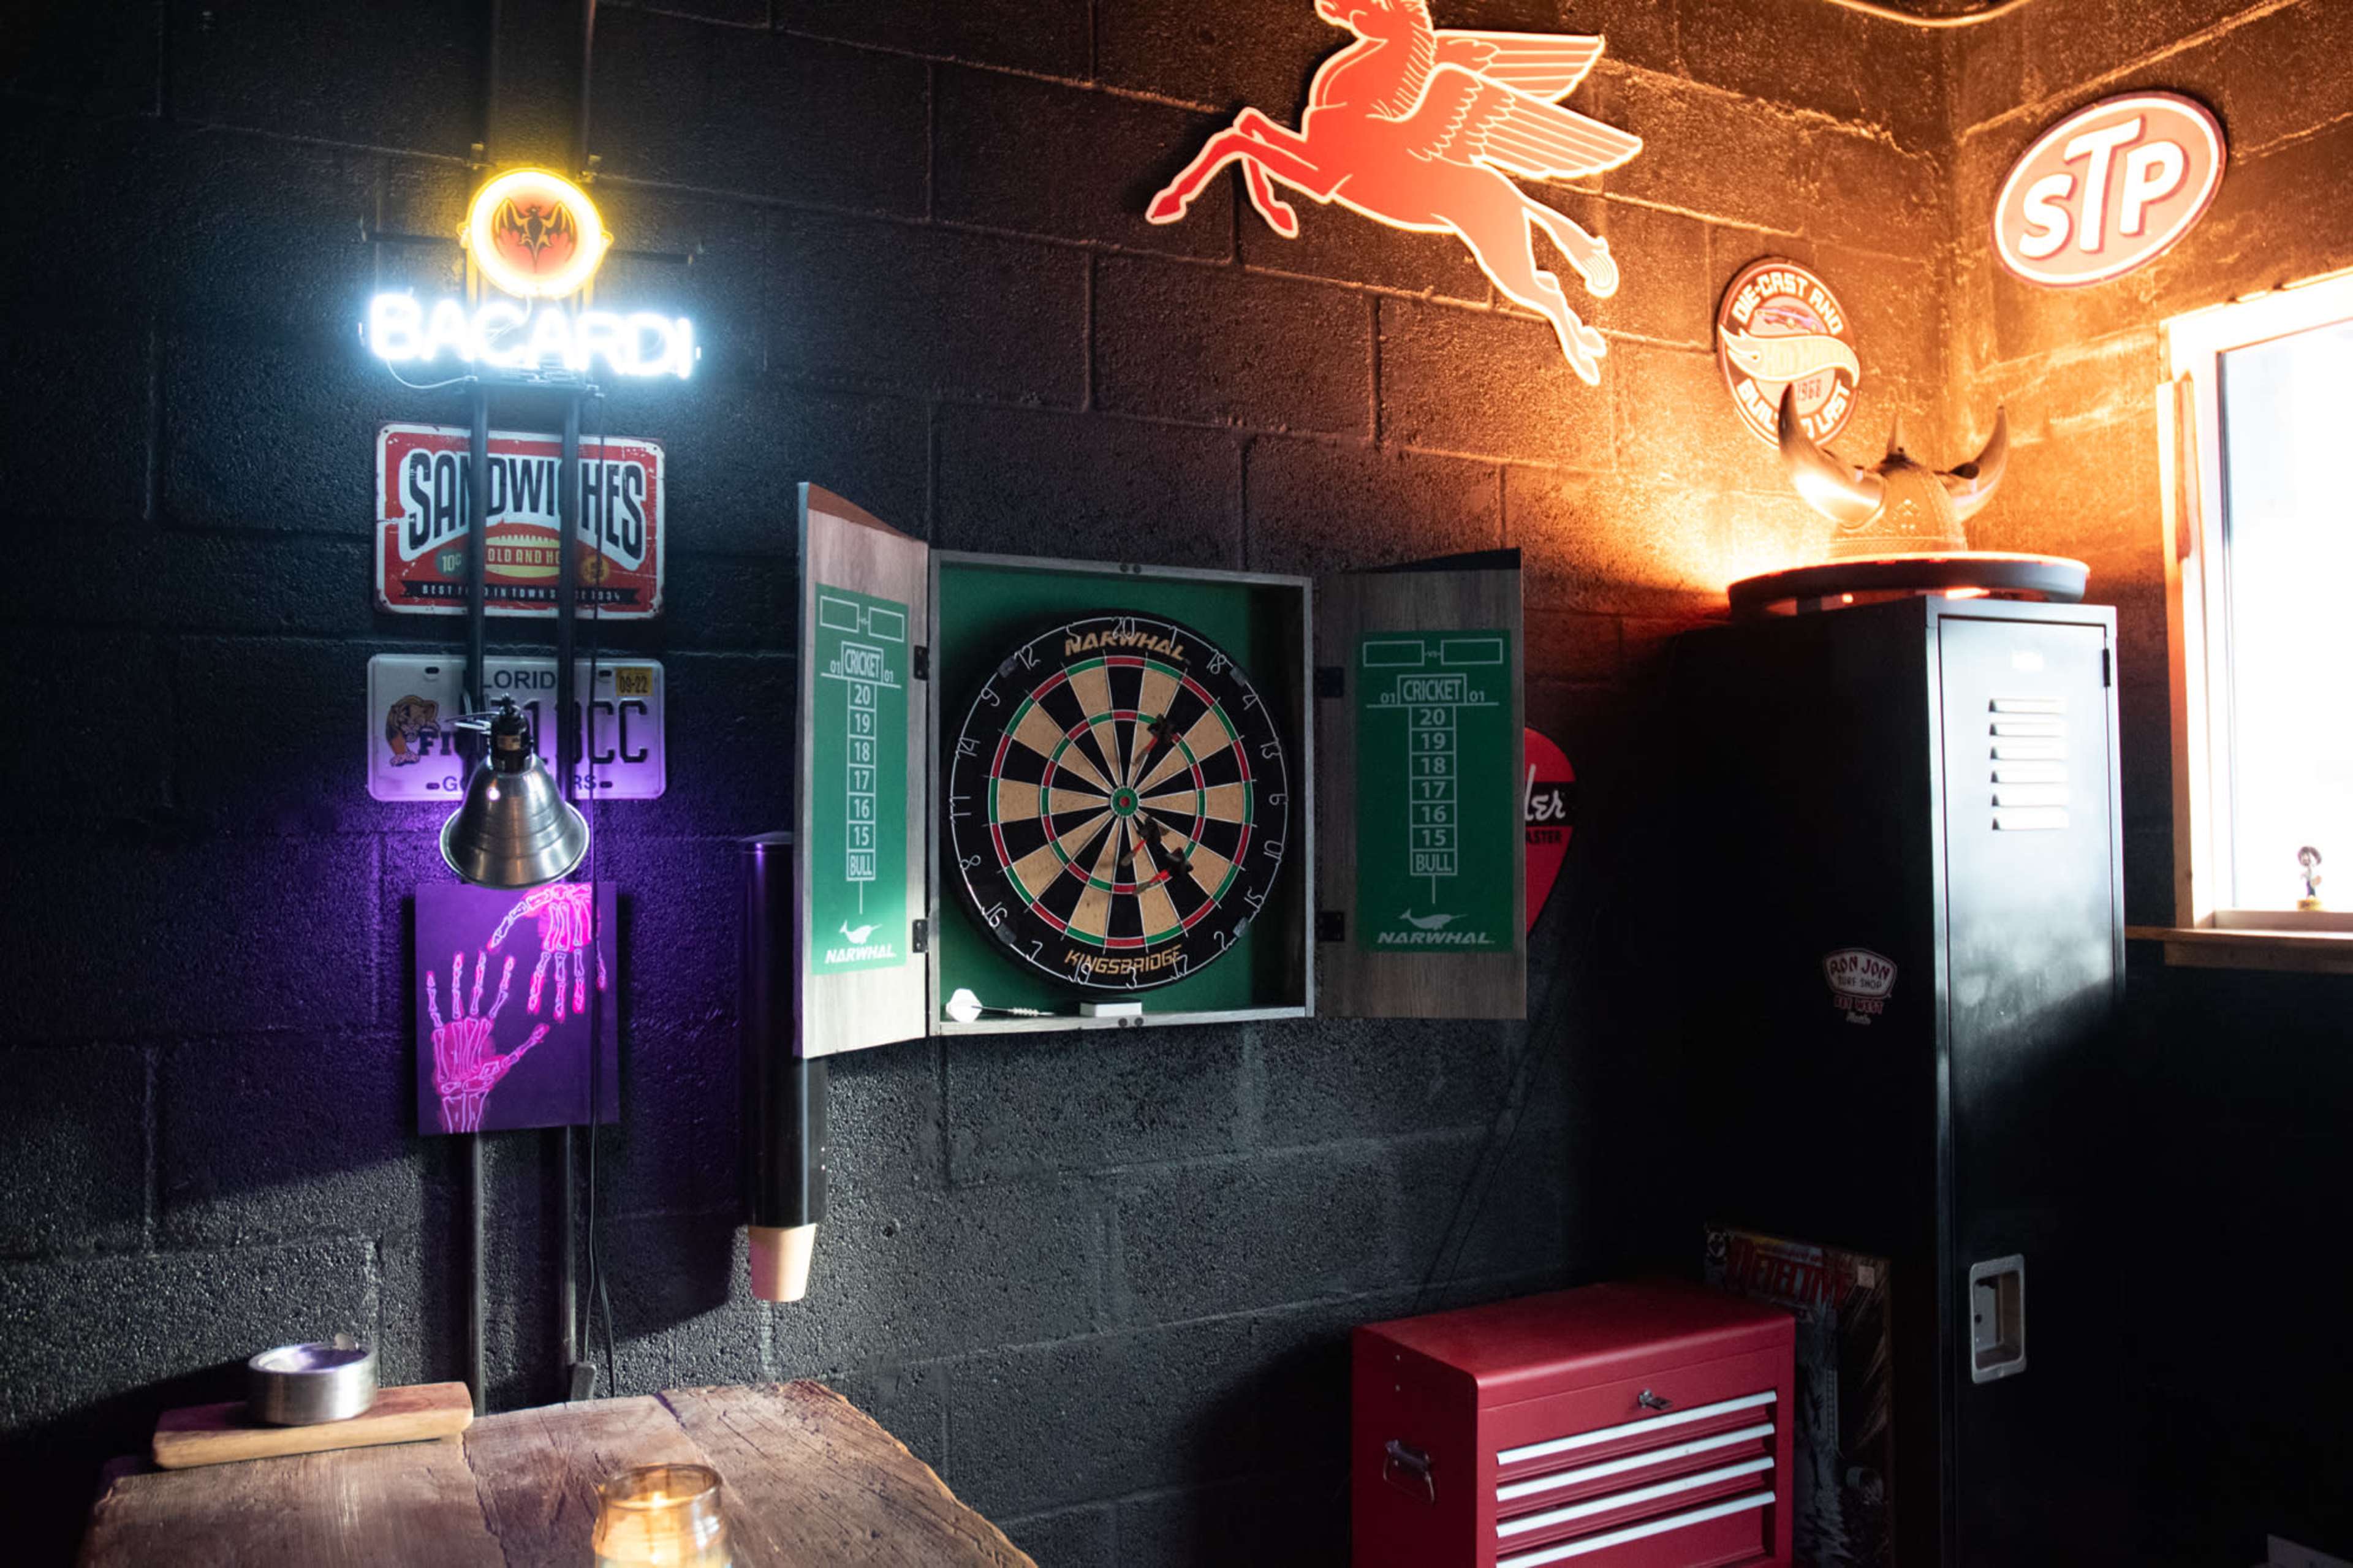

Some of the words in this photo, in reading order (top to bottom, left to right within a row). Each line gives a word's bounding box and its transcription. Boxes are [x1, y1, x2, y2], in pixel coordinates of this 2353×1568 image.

[2018, 116, 2188, 259] STP
[1809, 288, 1844, 335] AND
[369, 293, 692, 379] BACARDI
[1737, 378, 1778, 431] BUIL
[1815, 378, 1851, 434] LAST
[409, 451, 643, 561] SANDWIHES
[488, 548, 511, 562] OLD
[516, 549, 542, 563] AND
[422, 584, 452, 595] BEST
[494, 587, 506, 597] IN
[512, 588, 545, 599] TOWN
[1064, 631, 1185, 657] NARWHAL
[830, 660, 841, 674] 01
[844, 649, 881, 678] CRICKET
[884, 669, 894, 683] 01
[1014, 644, 1041, 670] 12
[619, 674, 648, 694] 09-22
[1380, 692, 1395, 704] 01
[1402, 680, 1461, 702] CRICKET
[1469, 691, 1485, 702] 01
[854, 684, 870, 705] 20
[854, 713, 870, 733] 19
[1419, 709, 1446, 725] 20
[1421, 733, 1446, 749] 19
[854, 742, 870, 761] 18
[1421, 757, 1446, 774] 18
[854, 771, 870, 790] 17
[1421, 781, 1446, 798] 17
[854, 798, 870, 819] 16
[1421, 806, 1446, 822] 16
[854, 827, 870, 846] 15
[1421, 830, 1446, 846] 15
[849, 855, 873, 876] BULL
[1415, 854, 1452, 873] BULL
[1377, 931, 1490, 944] NARWHAL
[825, 944, 895, 963] NARWHAL
[1064, 944, 1182, 975] KINGSBRIDGE
[1830, 955, 1859, 976] RON
[1862, 958, 1890, 980] JON
[1860, 979, 1882, 989] SHOP
